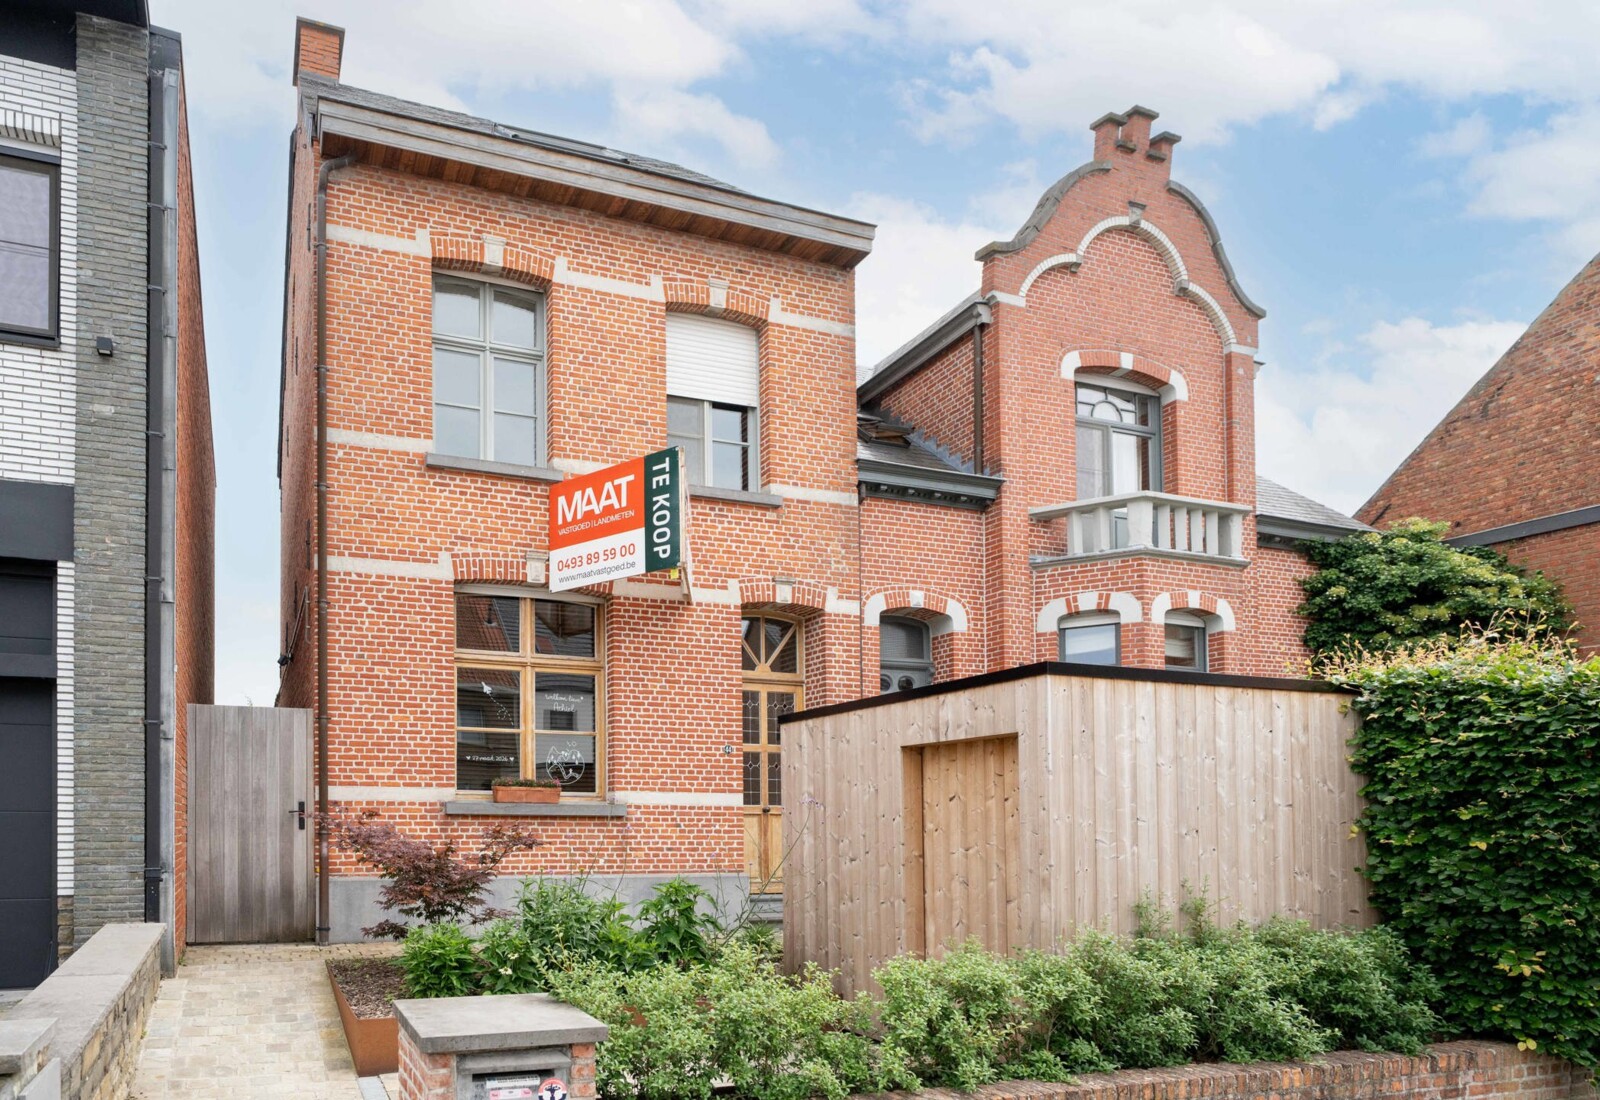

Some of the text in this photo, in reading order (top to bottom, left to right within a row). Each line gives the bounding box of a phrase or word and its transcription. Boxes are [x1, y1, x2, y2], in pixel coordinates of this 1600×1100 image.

[557, 474, 635, 525] MAAT
[652, 456, 671, 559] TE KOOP
[558, 509, 635, 536] VASTGOED LANDMETEN
[557, 543, 636, 572] 0493 89 59 00
[558, 561, 636, 583] www.maatvastgoed.be
